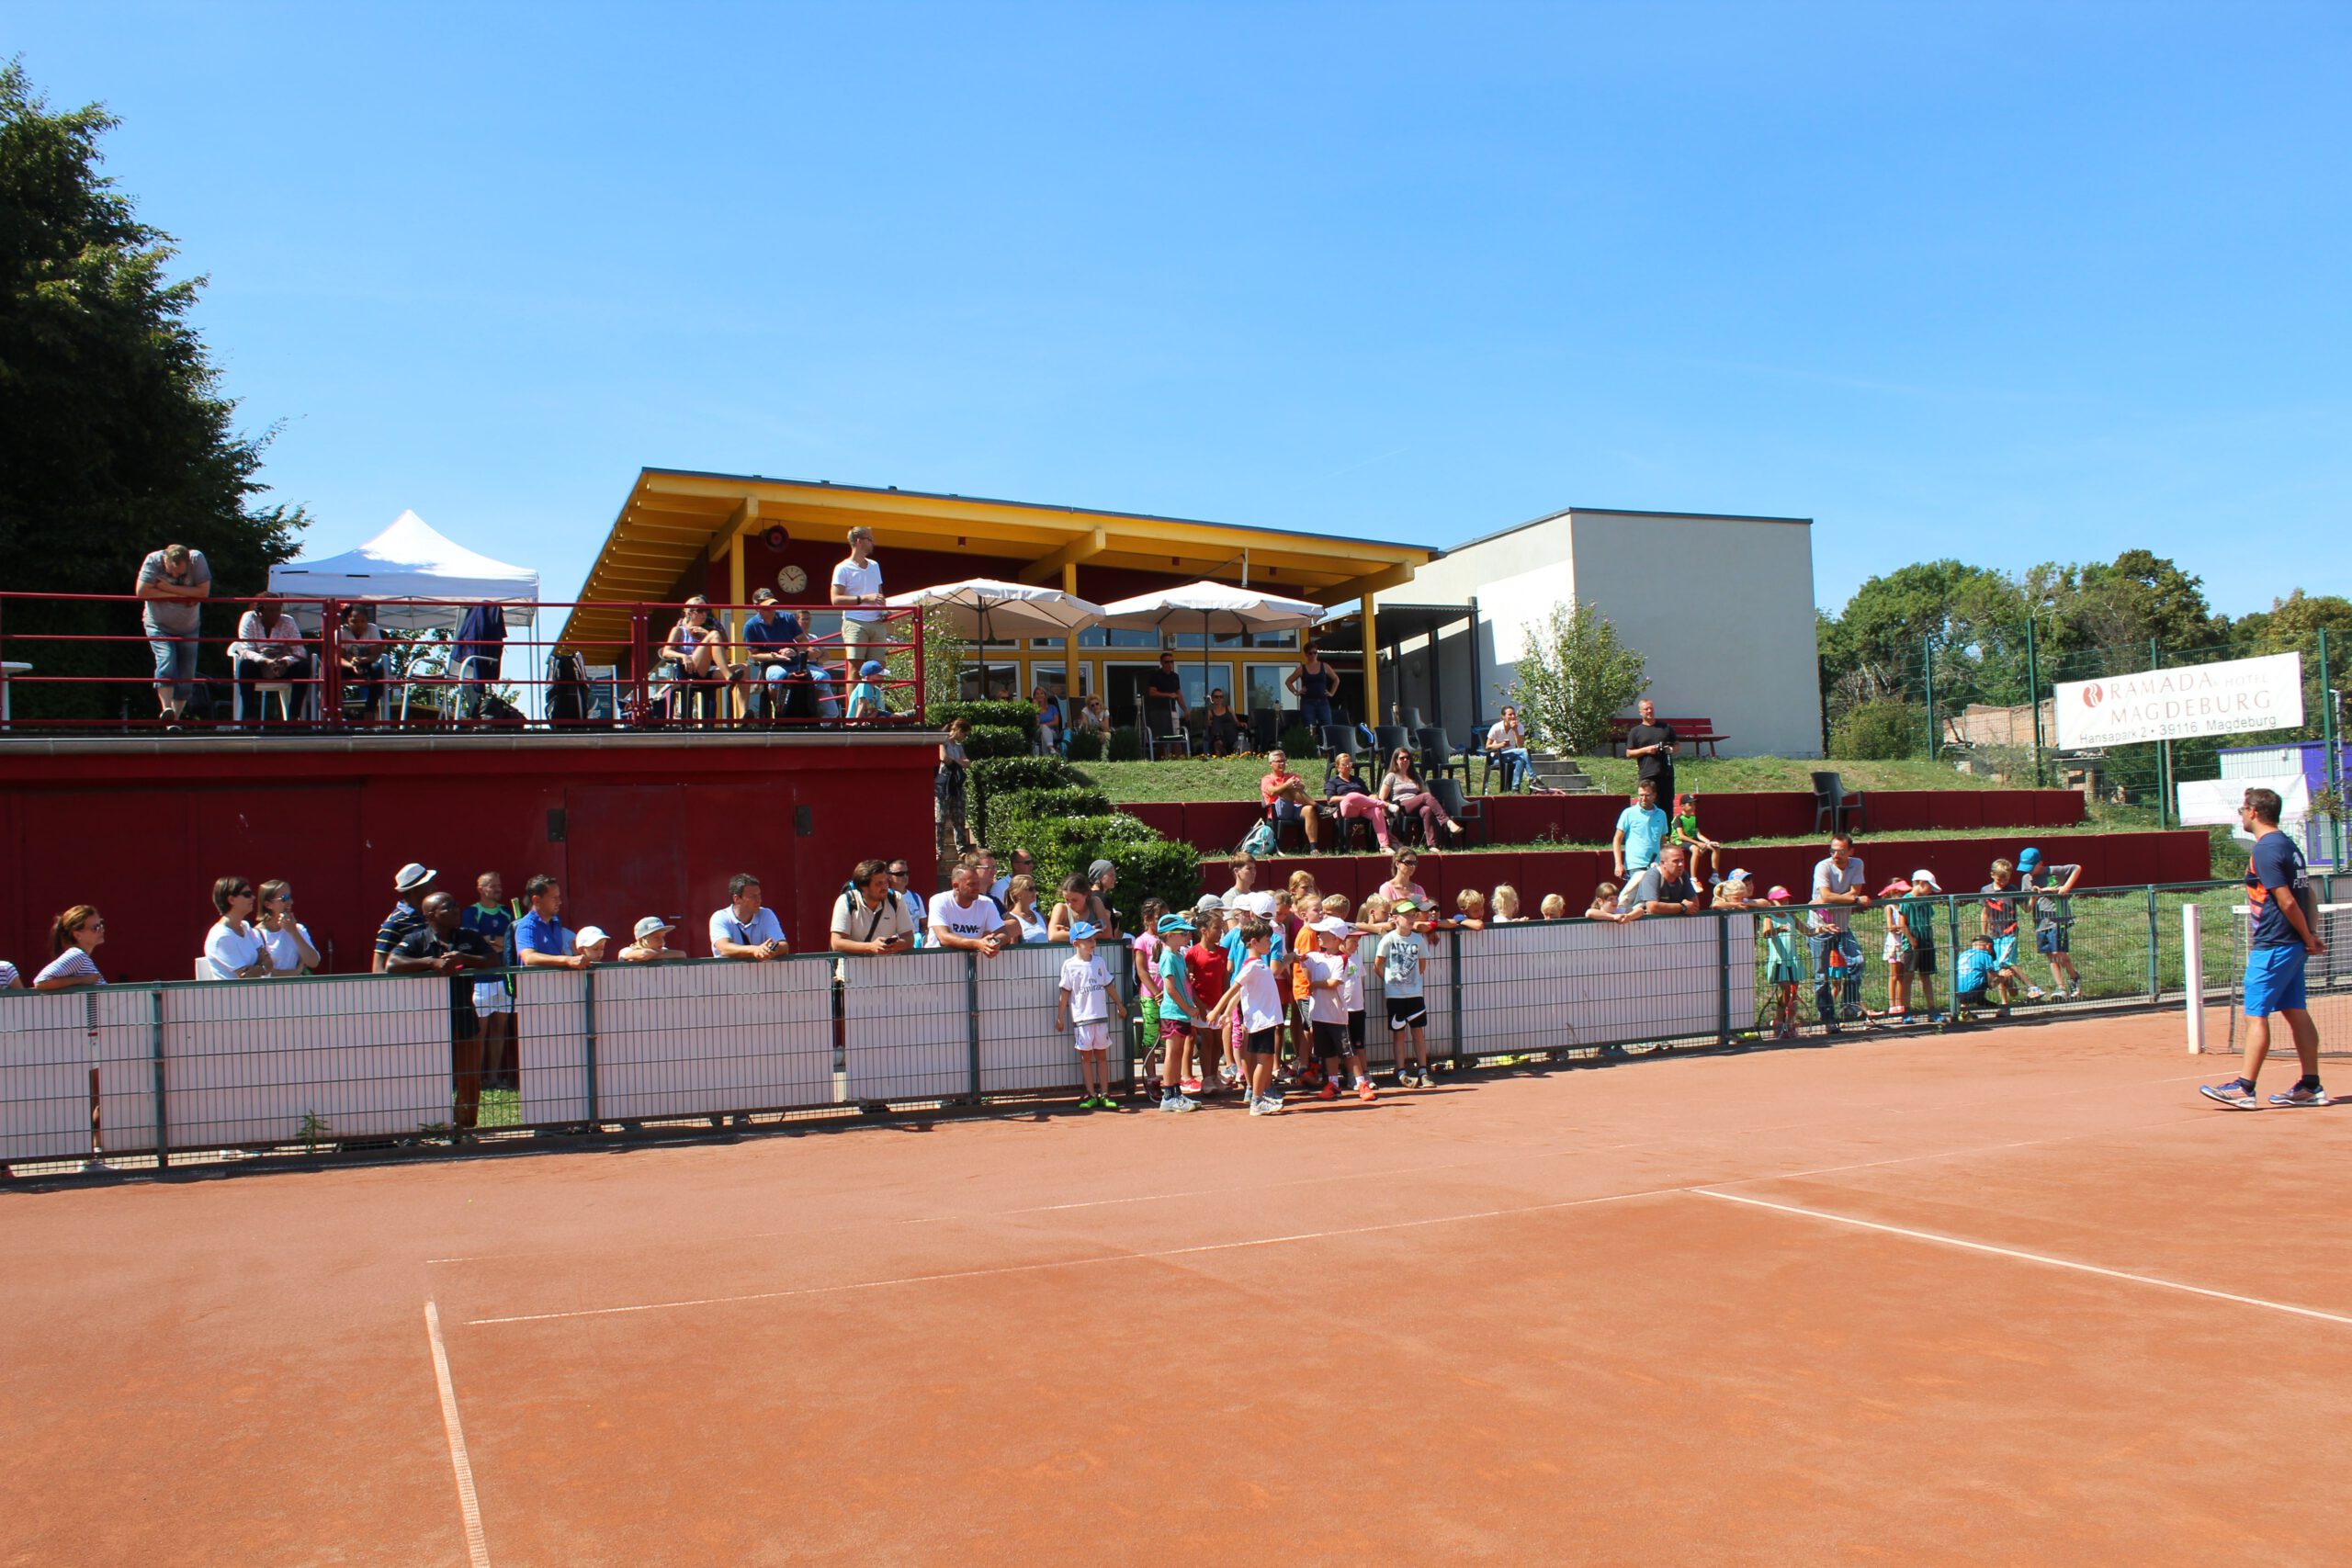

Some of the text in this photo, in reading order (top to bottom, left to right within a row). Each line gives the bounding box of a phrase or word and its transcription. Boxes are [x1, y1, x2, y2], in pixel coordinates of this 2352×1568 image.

[2110, 671, 2269, 699] RAMADA HOTEL
[2110, 690, 2271, 725] MAGDEBURG
[2079, 715, 2277, 745] Hansapark 2 39116 Magdeburg
[1391, 942, 1419, 954] NYC
